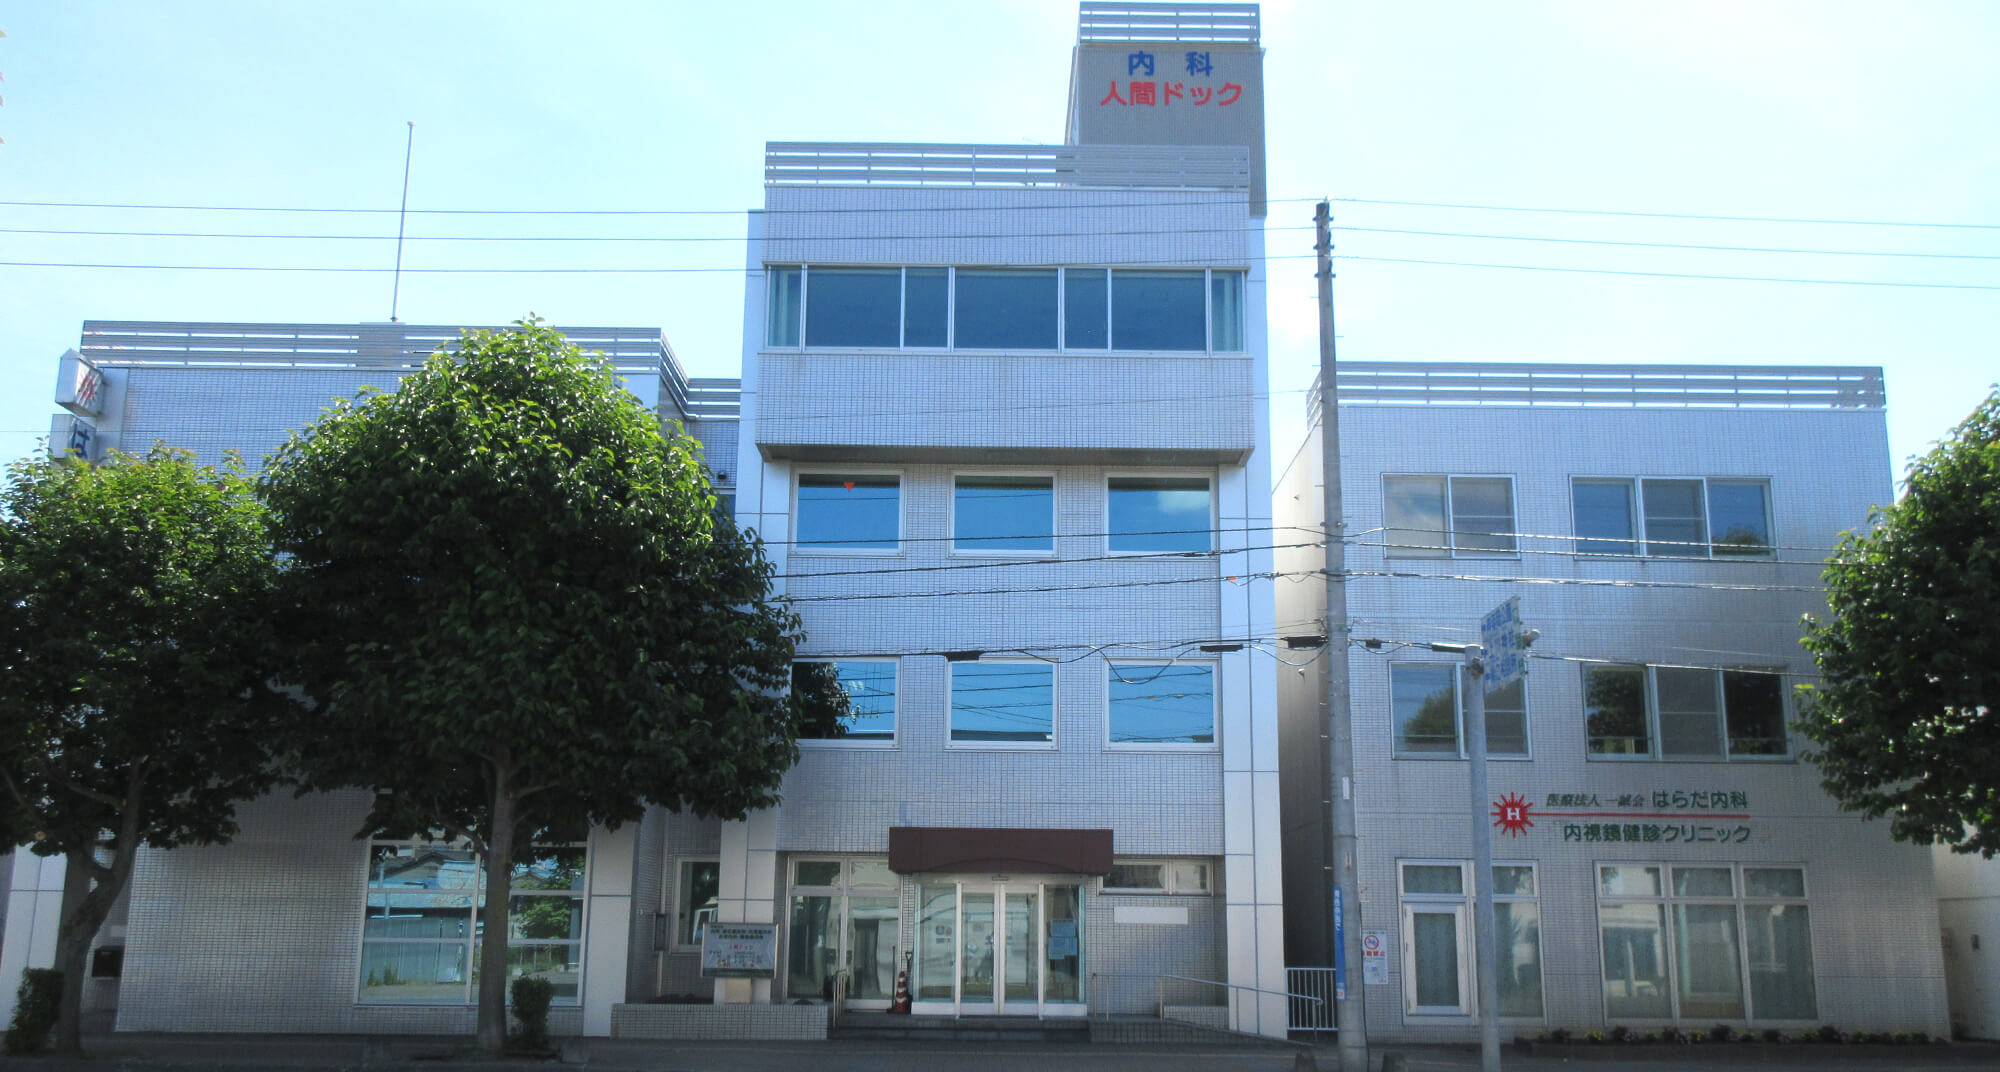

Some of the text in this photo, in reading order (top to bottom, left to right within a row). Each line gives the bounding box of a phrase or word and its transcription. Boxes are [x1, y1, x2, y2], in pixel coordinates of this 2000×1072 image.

[1127, 51, 1214, 77] 内科
[1100, 80, 1243, 106] 人間ドック
[1652, 790, 1748, 809] はらだ内科
[1506, 807, 1520, 821] H
[1564, 823, 1751, 843] 内視鏡健診クリニック
